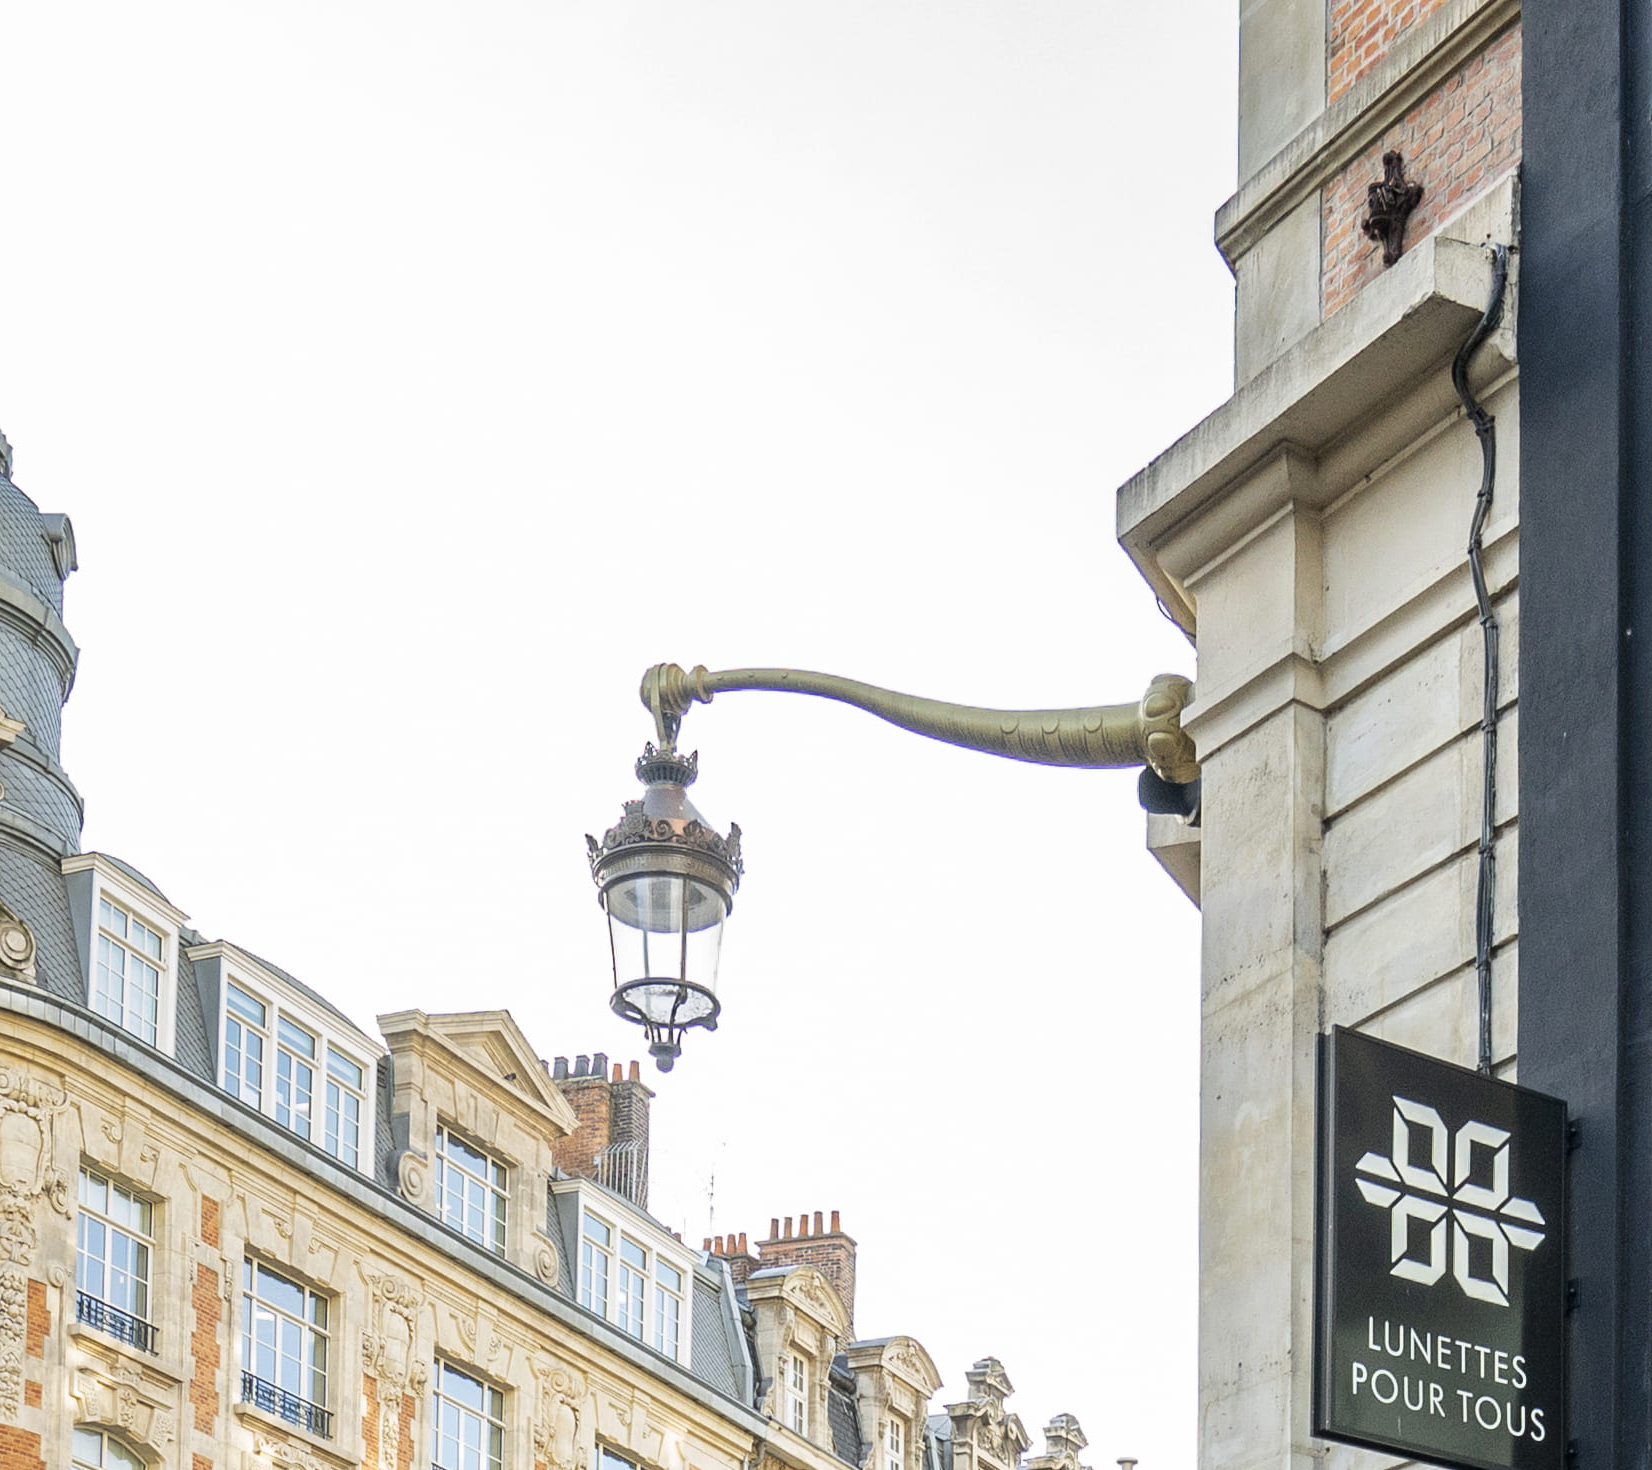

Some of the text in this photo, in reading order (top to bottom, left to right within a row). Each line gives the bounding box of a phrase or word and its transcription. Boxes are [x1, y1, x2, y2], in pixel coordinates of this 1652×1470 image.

[1368, 1316, 1527, 1389] LUNETTES
[1352, 1361, 1546, 1442] POUR TOUS
